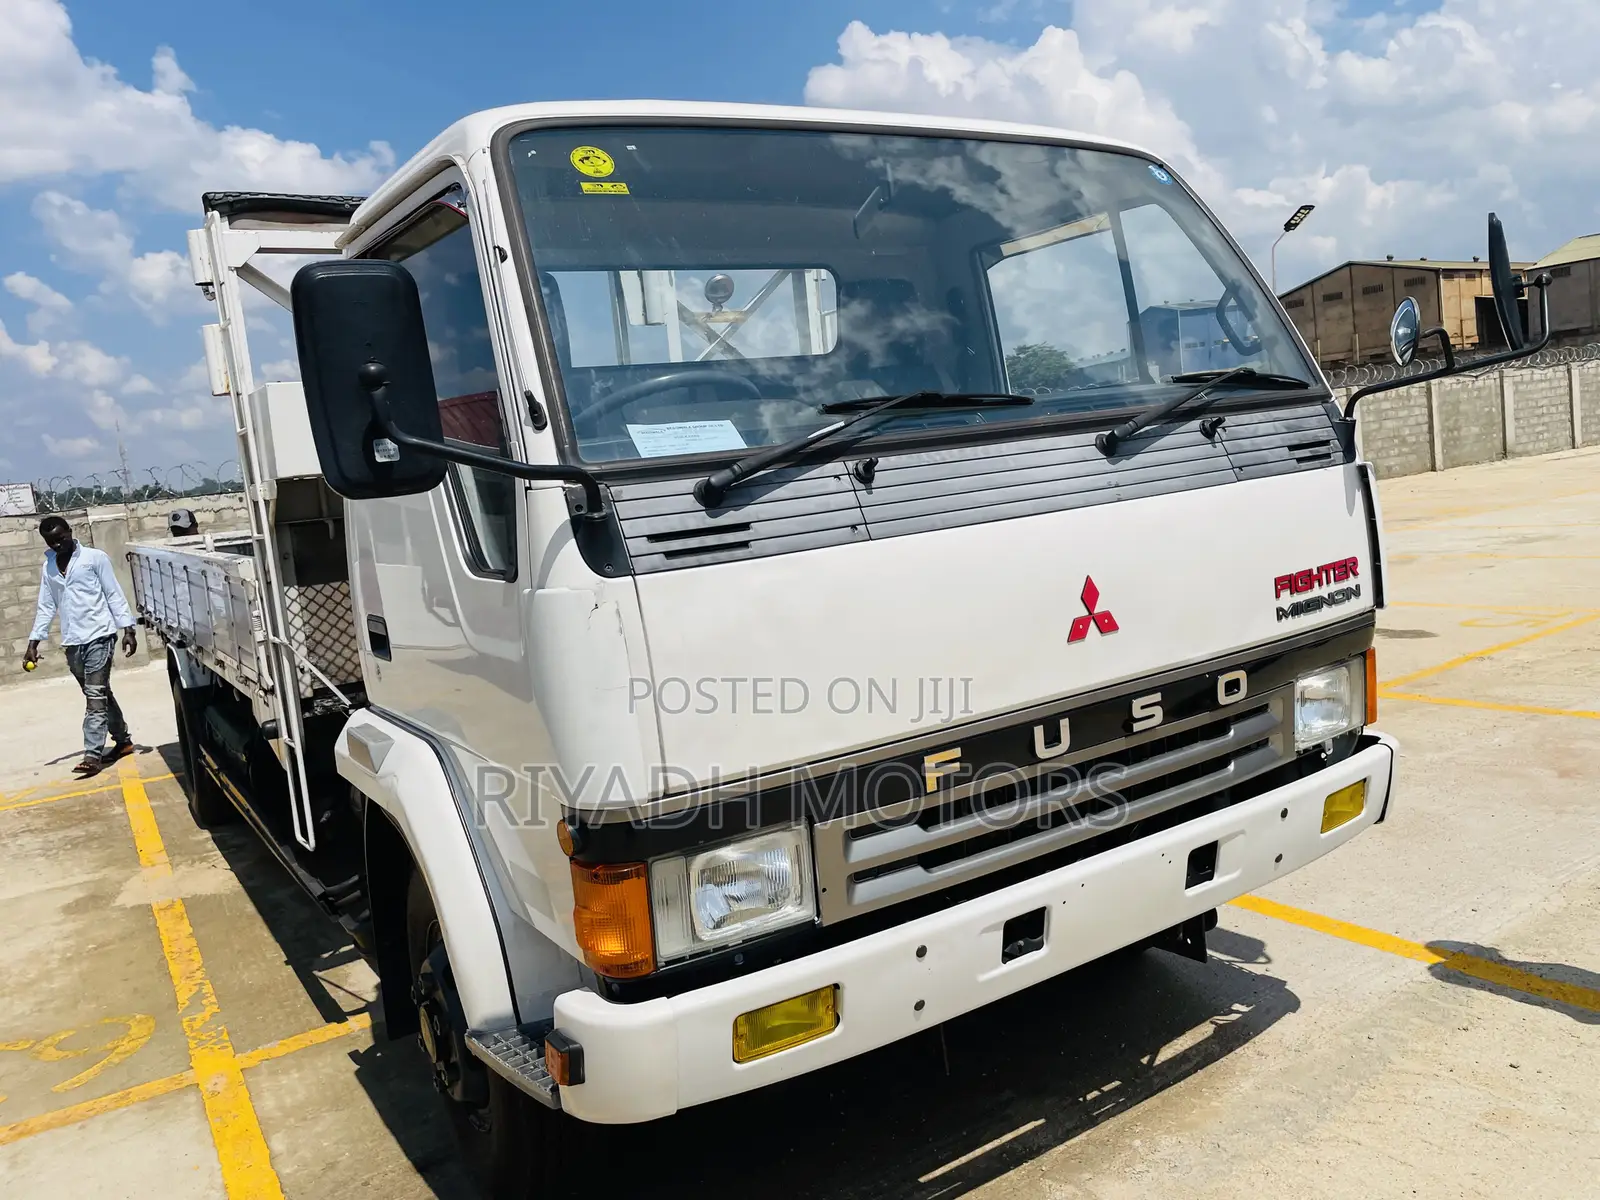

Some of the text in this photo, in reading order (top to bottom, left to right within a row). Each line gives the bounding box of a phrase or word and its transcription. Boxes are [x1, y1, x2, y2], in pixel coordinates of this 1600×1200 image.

[1274, 556, 1359, 599] FIGHTER
[1276, 583, 1361, 622] MIGNON
[923, 669, 1248, 793] FUSO
